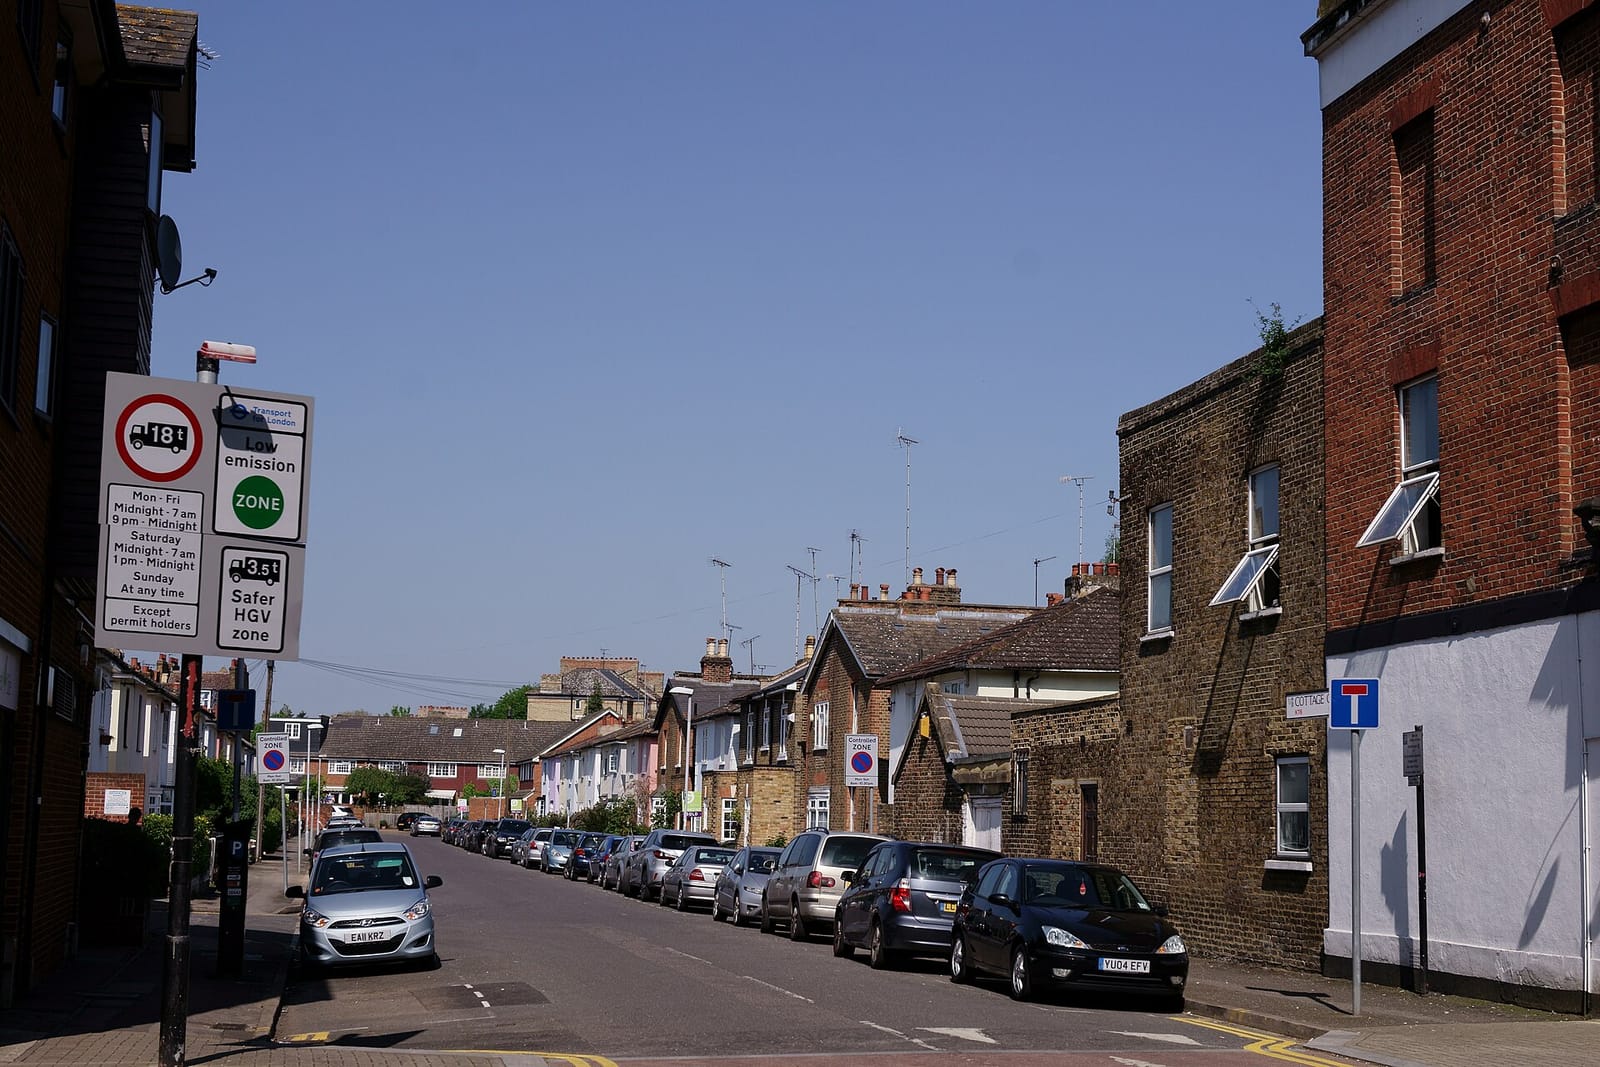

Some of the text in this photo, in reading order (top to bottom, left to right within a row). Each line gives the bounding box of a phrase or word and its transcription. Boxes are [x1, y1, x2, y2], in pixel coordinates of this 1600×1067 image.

[253, 406, 292, 418] Transport
[267, 416, 296, 426] London
[245, 436, 278, 453] Low
[225, 455, 295, 473] emission
[133, 491, 156, 502] Mon
[166, 495, 180, 504] Fri
[236, 494, 280, 511] ZONE
[114, 503, 164, 516] Midnight
[148, 518, 197, 532] Midnight
[131, 531, 181, 545] Saturday
[114, 543, 163, 557] Midnight
[147, 558, 195, 572] Midnight
[133, 571, 174, 585] Sunday
[121, 584, 184, 598] At any time
[232, 589, 275, 606] Safer
[134, 605, 171, 618] Except
[234, 608, 271, 623] HGV
[110, 616, 191, 630] permit holders
[232, 629, 269, 641] zone
[1295, 695, 1324, 706] COTTAGE
[232, 841, 242, 855] P
[368, 931, 384, 940] KRZ
[1104, 960, 1128, 970] YU04
